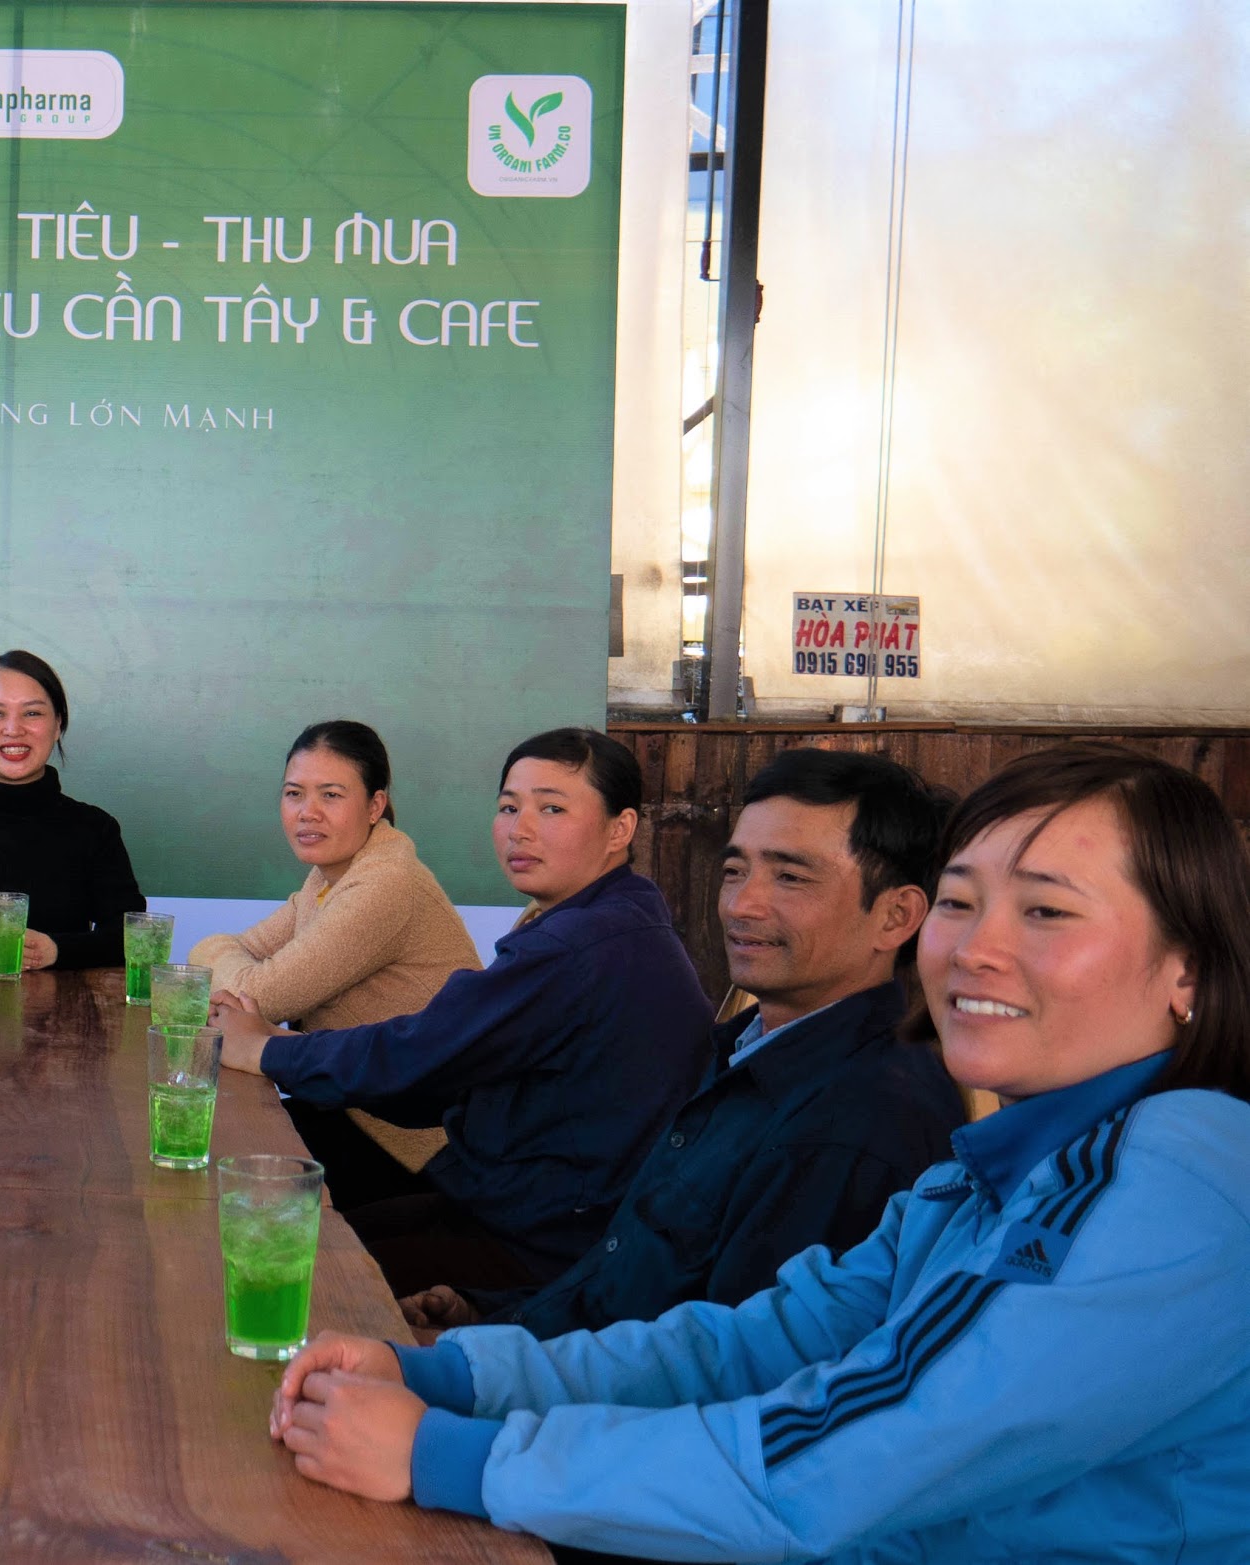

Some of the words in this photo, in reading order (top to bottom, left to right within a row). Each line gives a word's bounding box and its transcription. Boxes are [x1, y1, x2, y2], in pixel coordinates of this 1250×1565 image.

[20, 113, 91, 124] GROUP
[491, 143, 532, 173] ORGANI
[17, 200, 138, 261] TIÊU
[162, 241, 180, 249] -
[203, 216, 312, 264] THU
[334, 212, 457, 266] MUA
[62, 270, 181, 342] CẦN
[203, 283, 319, 344] TÂY
[342, 298, 377, 345] &
[398, 299, 540, 348] CAFE
[69, 398, 141, 427] LỚN
[163, 403, 273, 432] MẠNH
[797, 598, 836, 613] BẠT
[795, 612, 845, 648] HÒA
[854, 615, 918, 651] PHÁT
[795, 651, 837, 674] 0915
[885, 654, 918, 677] 955
[1005, 1256, 1052, 1278] adidas
